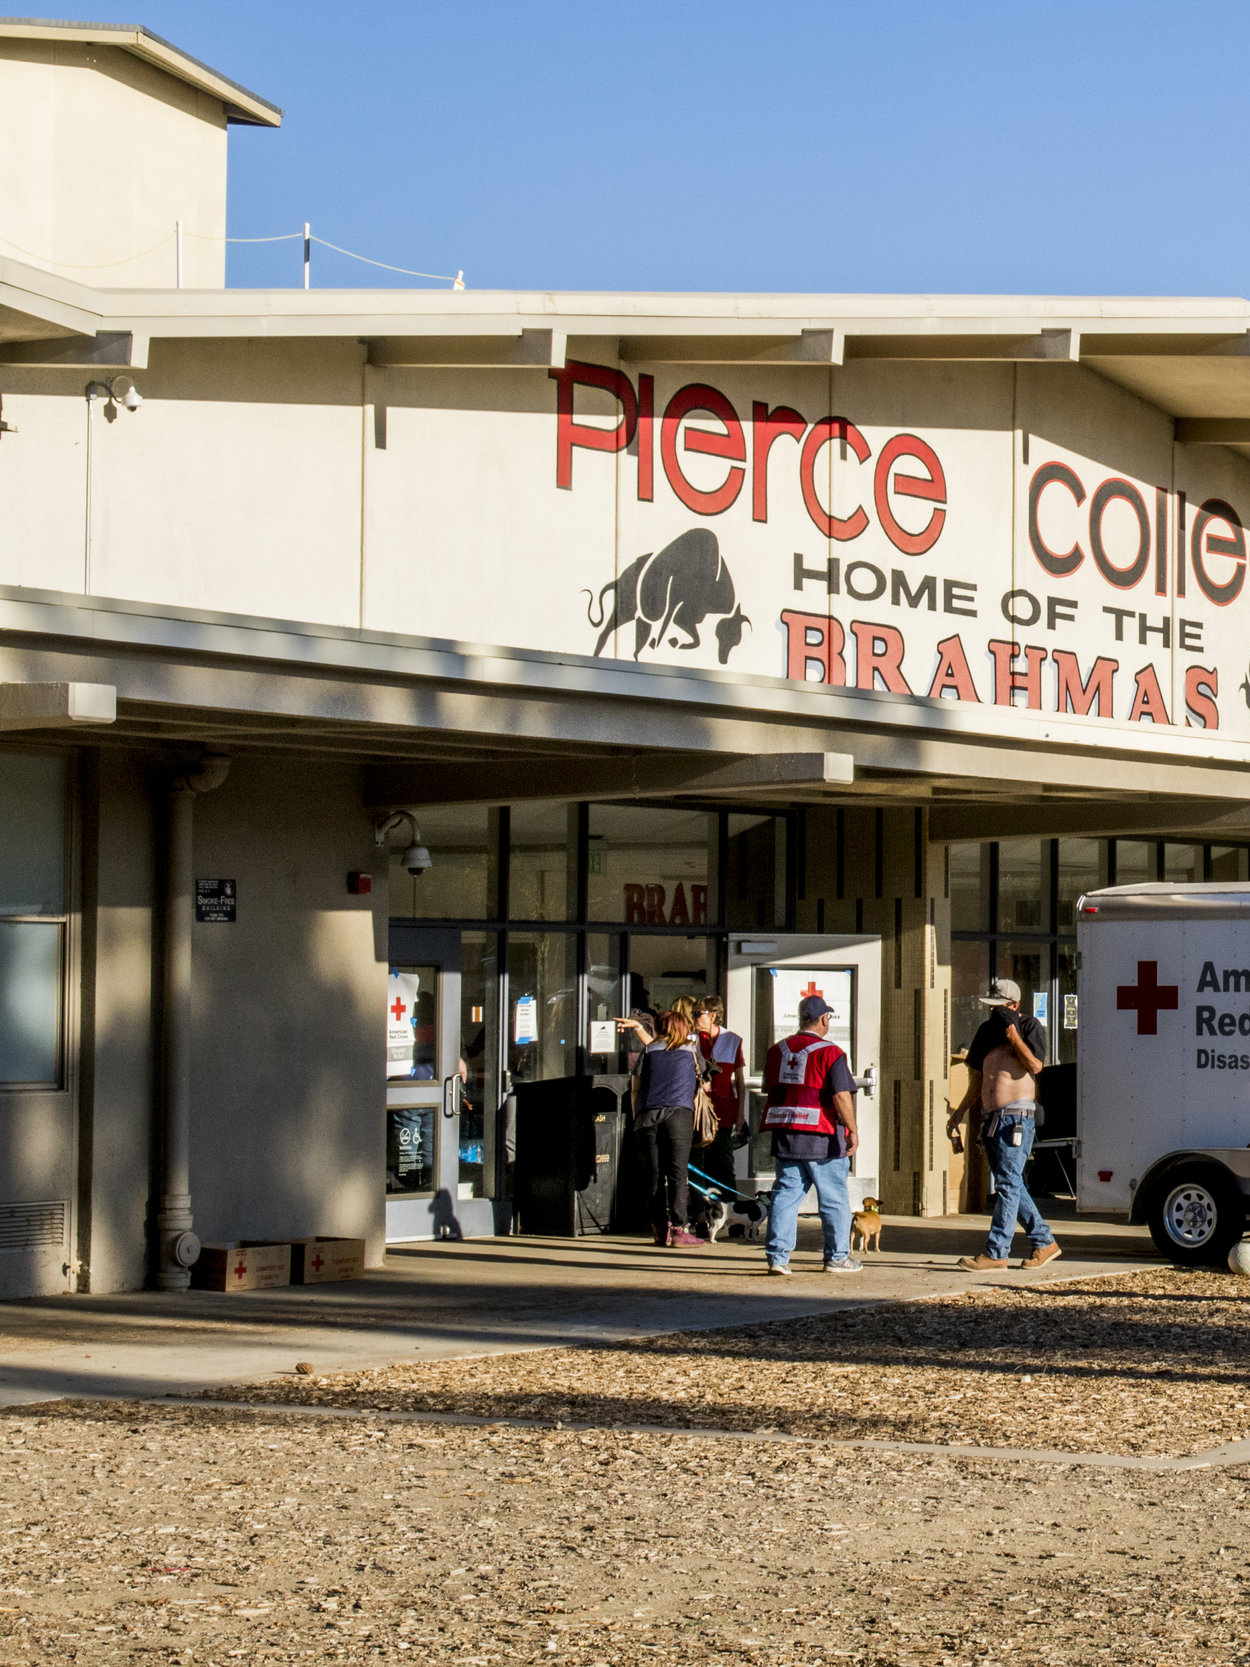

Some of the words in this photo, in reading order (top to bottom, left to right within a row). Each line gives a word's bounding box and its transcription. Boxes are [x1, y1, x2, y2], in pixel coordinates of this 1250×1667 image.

[793, 552, 978, 618] HOME
[1000, 588, 1079, 630] OF
[1102, 605, 1205, 653] THE
[778, 608, 1220, 730] BRAHMAS
